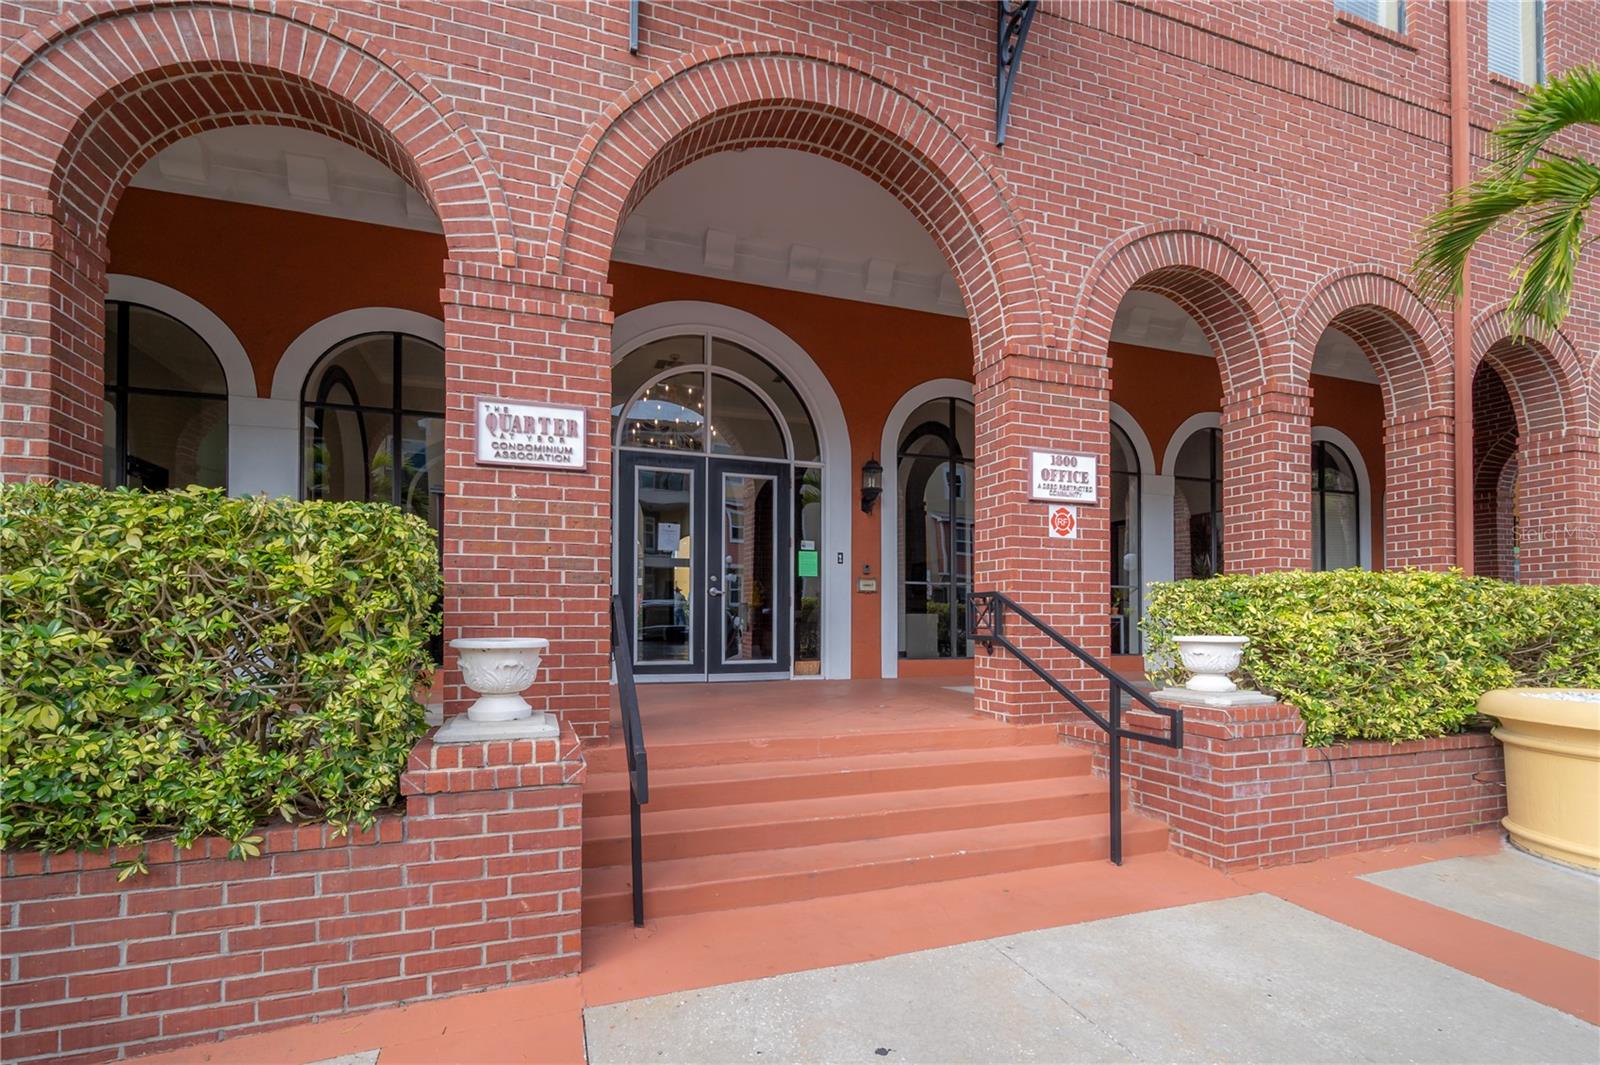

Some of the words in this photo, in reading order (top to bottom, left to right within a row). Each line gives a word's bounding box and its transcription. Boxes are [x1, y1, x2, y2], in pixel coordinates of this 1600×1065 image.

[485, 405, 509, 413] THE
[485, 412, 578, 438] QUARTER
[527, 435, 566, 444] YBOR
[491, 442, 573, 455] CONDOMINIUM
[494, 451, 571, 463] ASSOCIATION
[1050, 455, 1078, 467] 1800
[1041, 468, 1090, 484] OFFICE
